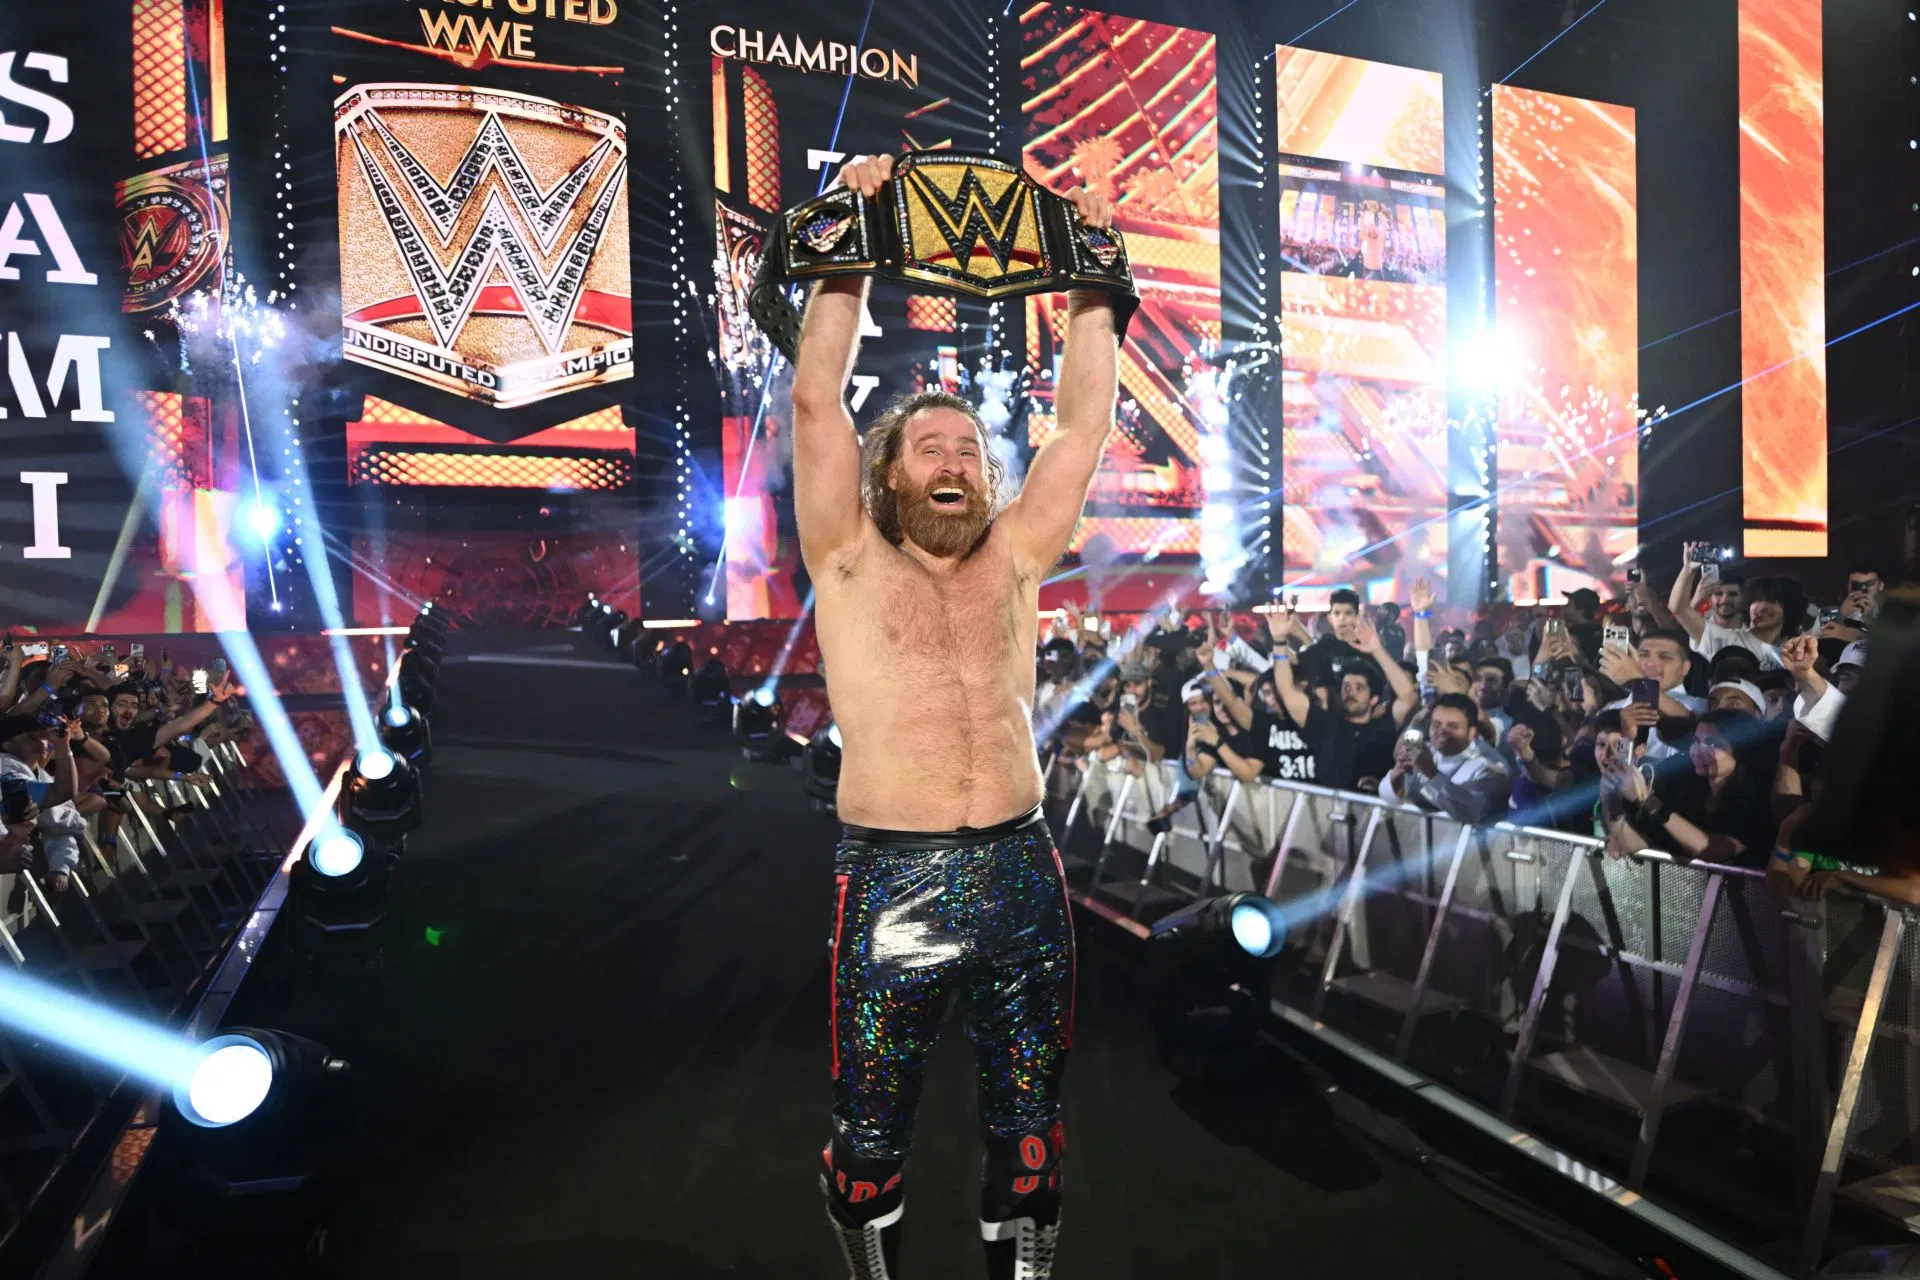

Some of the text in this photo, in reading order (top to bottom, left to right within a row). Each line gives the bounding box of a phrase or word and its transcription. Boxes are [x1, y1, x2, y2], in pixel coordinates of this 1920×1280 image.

[419, 8, 536, 59] WWE
[710, 25, 919, 90] CHAMPION
[1268, 724, 1308, 751] Aus
